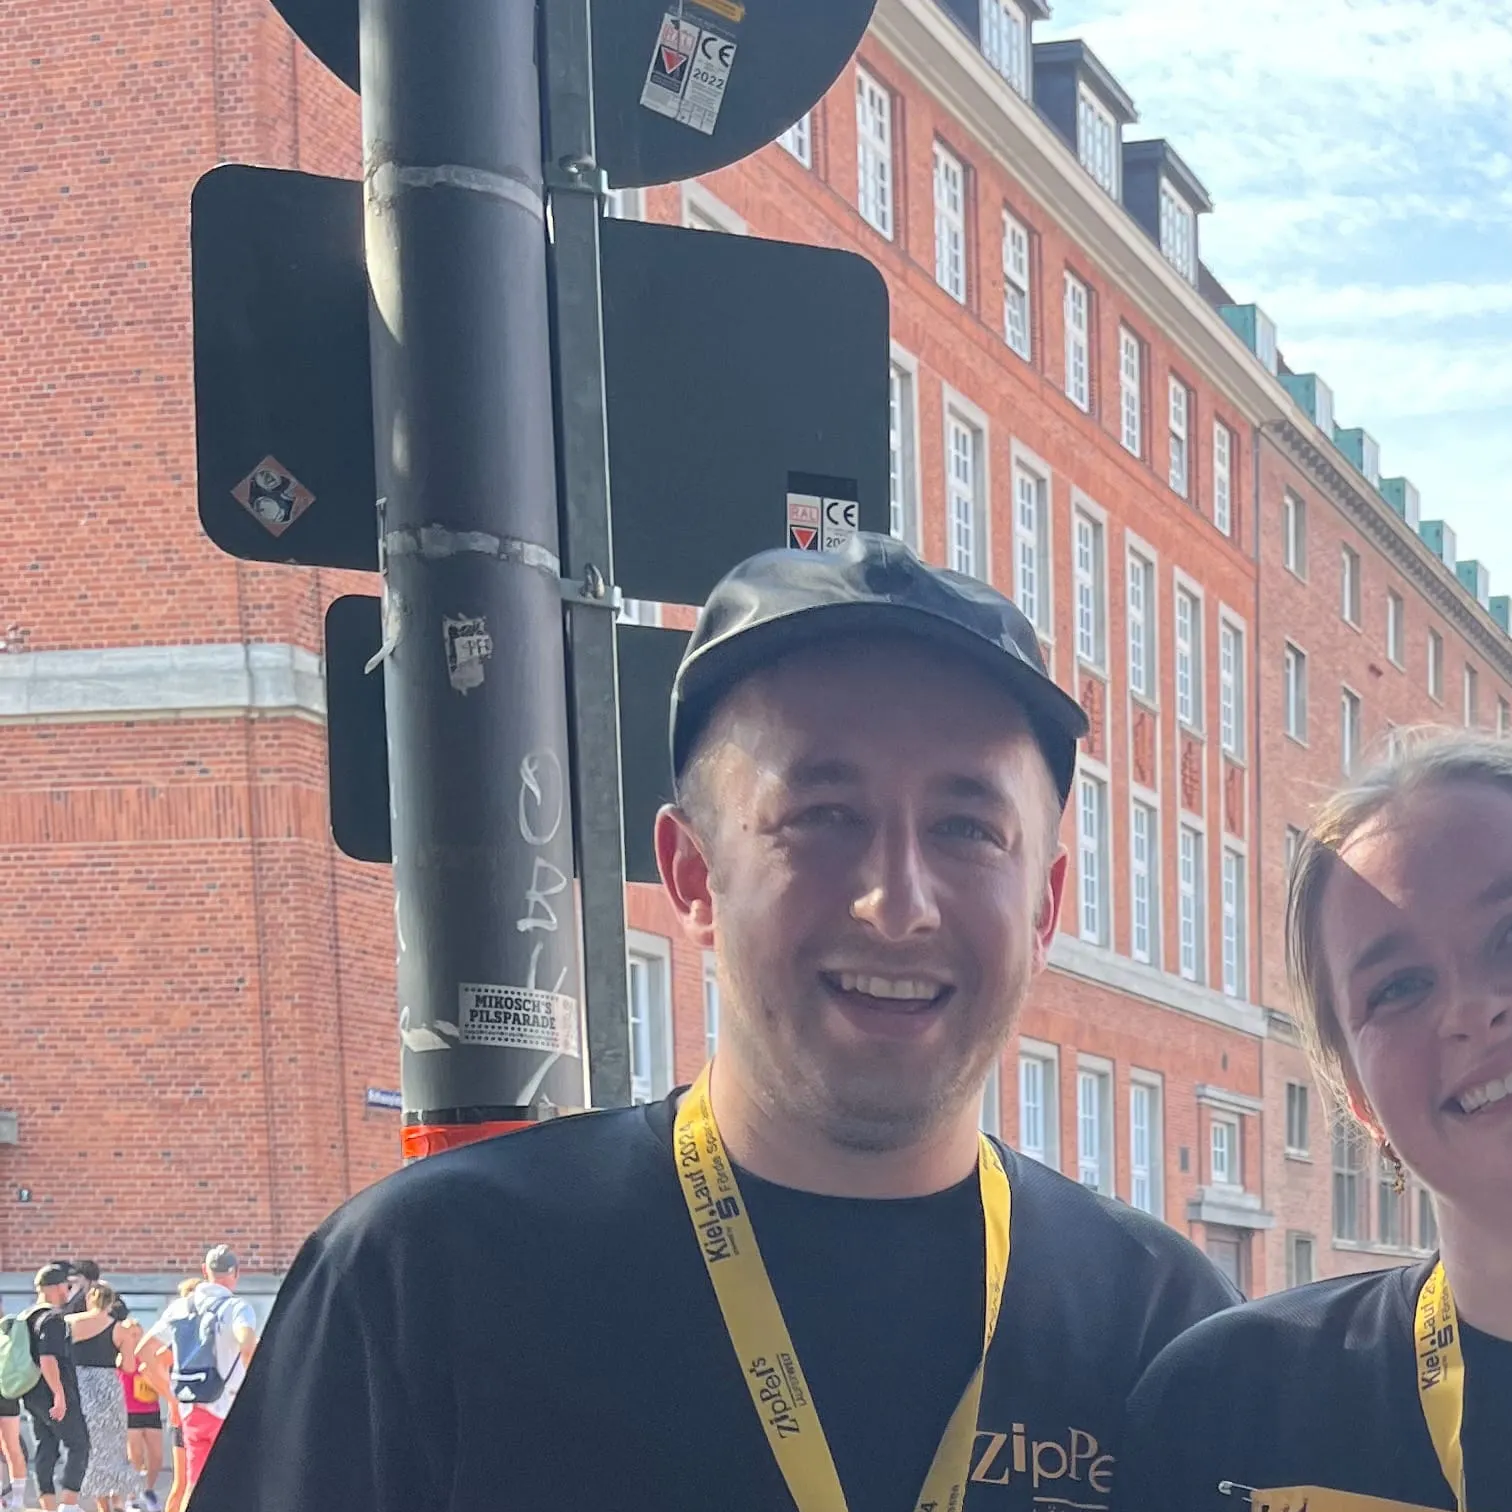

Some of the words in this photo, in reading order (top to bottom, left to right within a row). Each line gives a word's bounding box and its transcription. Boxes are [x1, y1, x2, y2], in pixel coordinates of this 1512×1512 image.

[693, 68, 725, 90] 2022
[791, 507, 817, 521] RAL
[826, 502, 856, 527] CE
[826, 535, 846, 549] 20
[475, 995, 552, 1014] MIKOSCH'S
[469, 1010, 556, 1029] PILSPARADE
